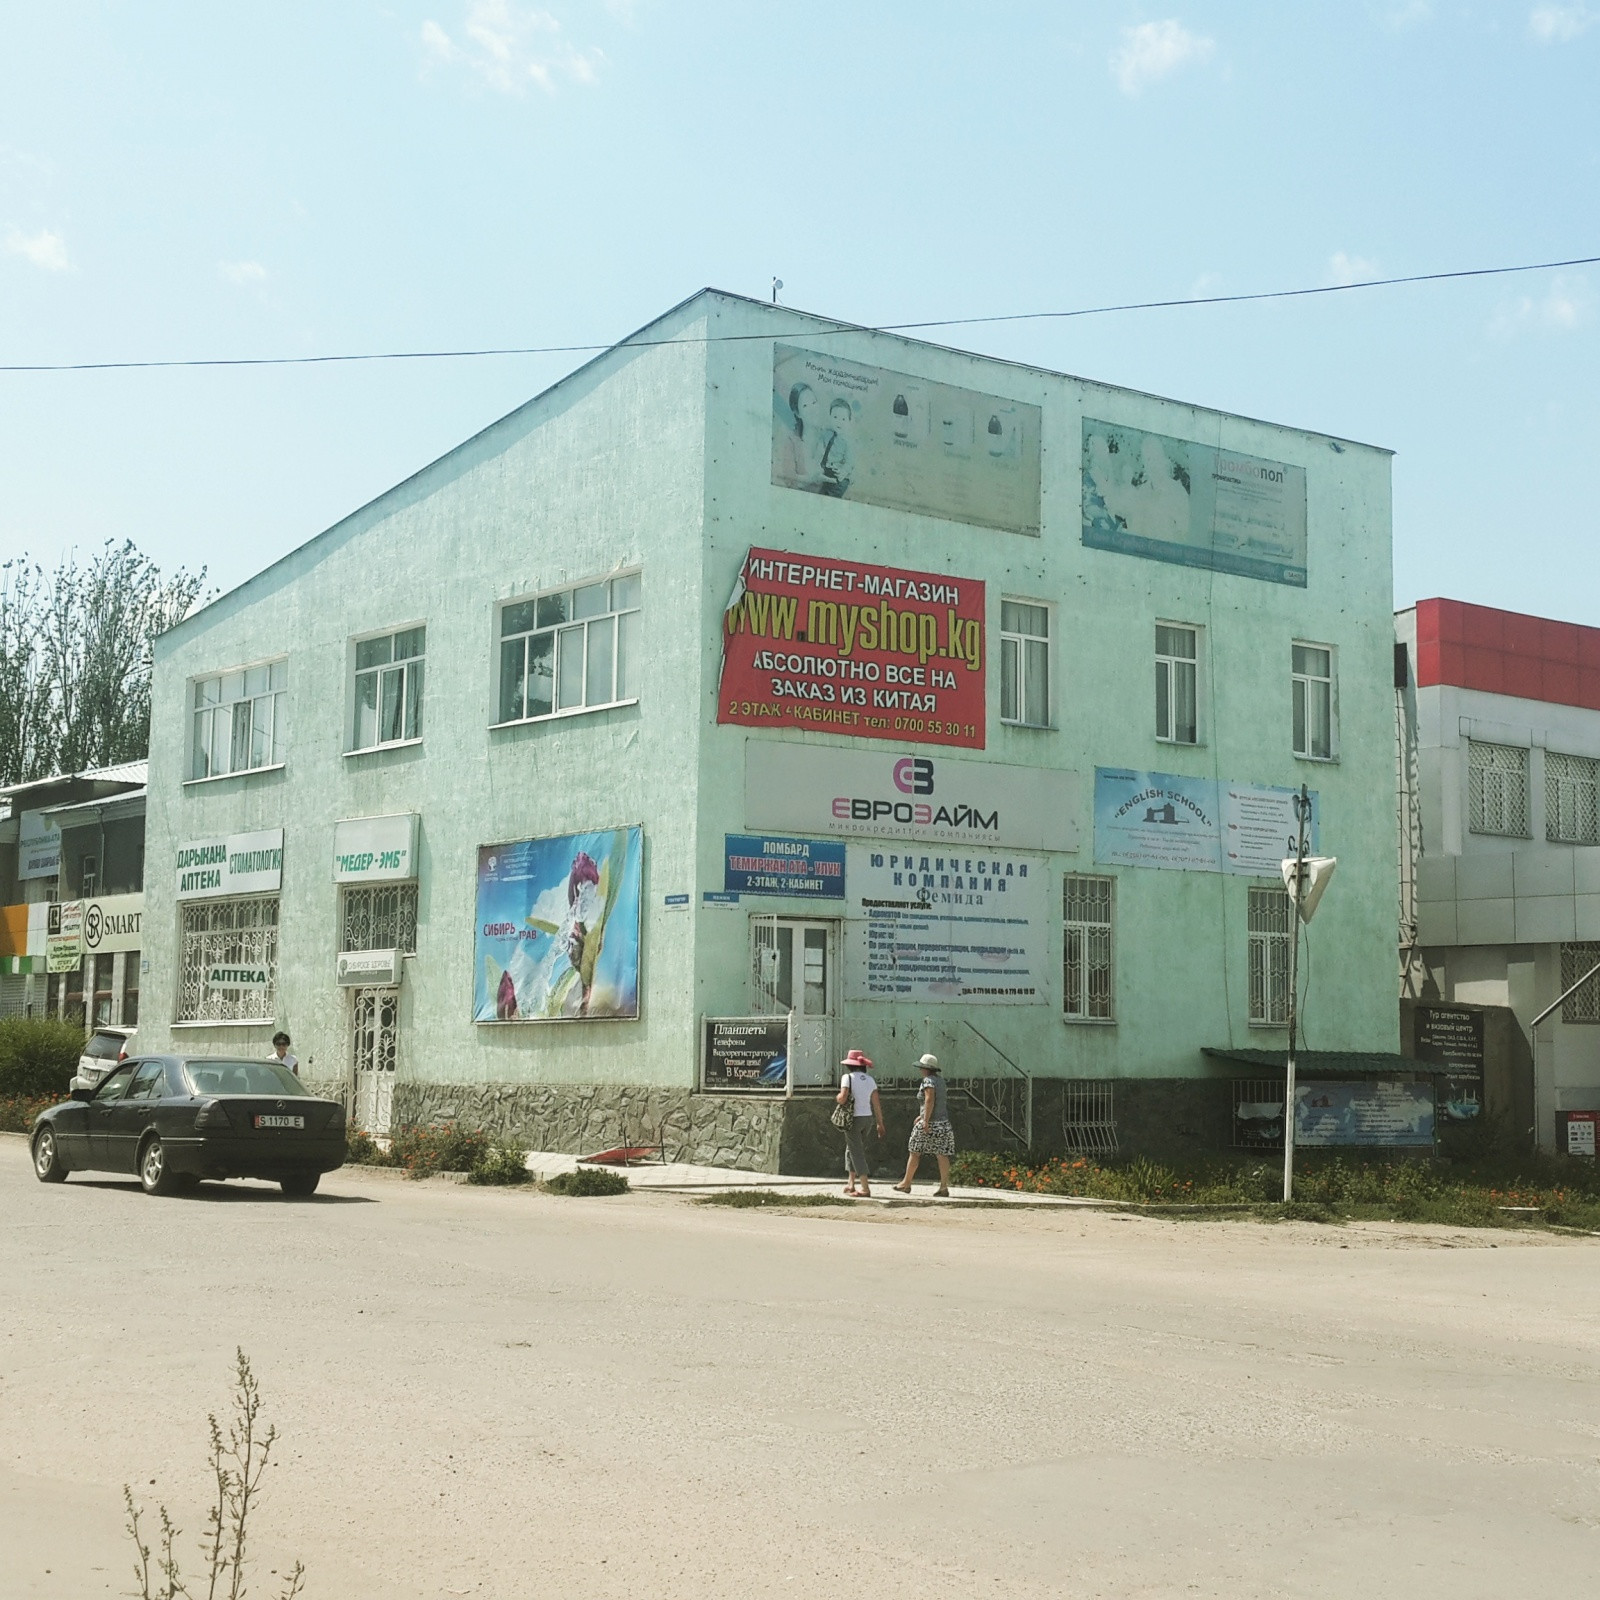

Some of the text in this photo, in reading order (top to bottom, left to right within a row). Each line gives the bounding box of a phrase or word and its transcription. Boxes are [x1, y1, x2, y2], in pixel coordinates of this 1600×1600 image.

[749, 558, 959, 606] ИНТЕРНЕТ-МАГАЗИН
[753, 650, 957, 690] АБСОЛЮТНО ВСЕ НА
[771, 678, 936, 713] ЗАКАЗ ИЗ КИТАЯ
[729, 701, 738, 715] 2
[741, 702, 781, 716] ЭТАЖ
[794, 705, 860, 725] КАБИНЕТ
[863, 716, 890, 729] тел:
[894, 717, 924, 732] 0700
[928, 720, 942, 734] 55
[945, 723, 960, 736] 30
[964, 724, 976, 738] 11
[177, 844, 227, 869] ДАРЫКАНА
[763, 841, 810, 858] ЛОМБАРД
[229, 848, 282, 875] СТОМАТОЛОГИЯ
[729, 855, 787, 873] ТЕМИРЖАН
[788, 859, 808, 875] АТА
[870, 853, 1028, 878] ЮРИДИЧЕСКАЯ
[181, 869, 221, 892] АПТЕКА
[780, 877, 824, 890] 2-КАБИНЕТ
[893, 872, 1007, 892] КОМПАНИЯ
[916, 887, 984, 906] Фемида
[105, 912, 142, 935] SMART
[483, 922, 516, 937] СИБИРЬ
[519, 929, 537, 940] ТРАВ
[210, 969, 266, 983] АПТЕКА
[1441, 1012, 1470, 1021] агентство
[714, 1024, 767, 1035] Планшеты
[1431, 1022, 1455, 1031] визовый
[1455, 1025, 1473, 1033] центр
[713, 1037, 746, 1048] Телефоны
[712, 1048, 779, 1059] Видеорегистраторы
[726, 1067, 732, 1077] В
[734, 1067, 760, 1080] Кредит
[259, 1115, 301, 1127] S 1170 E
